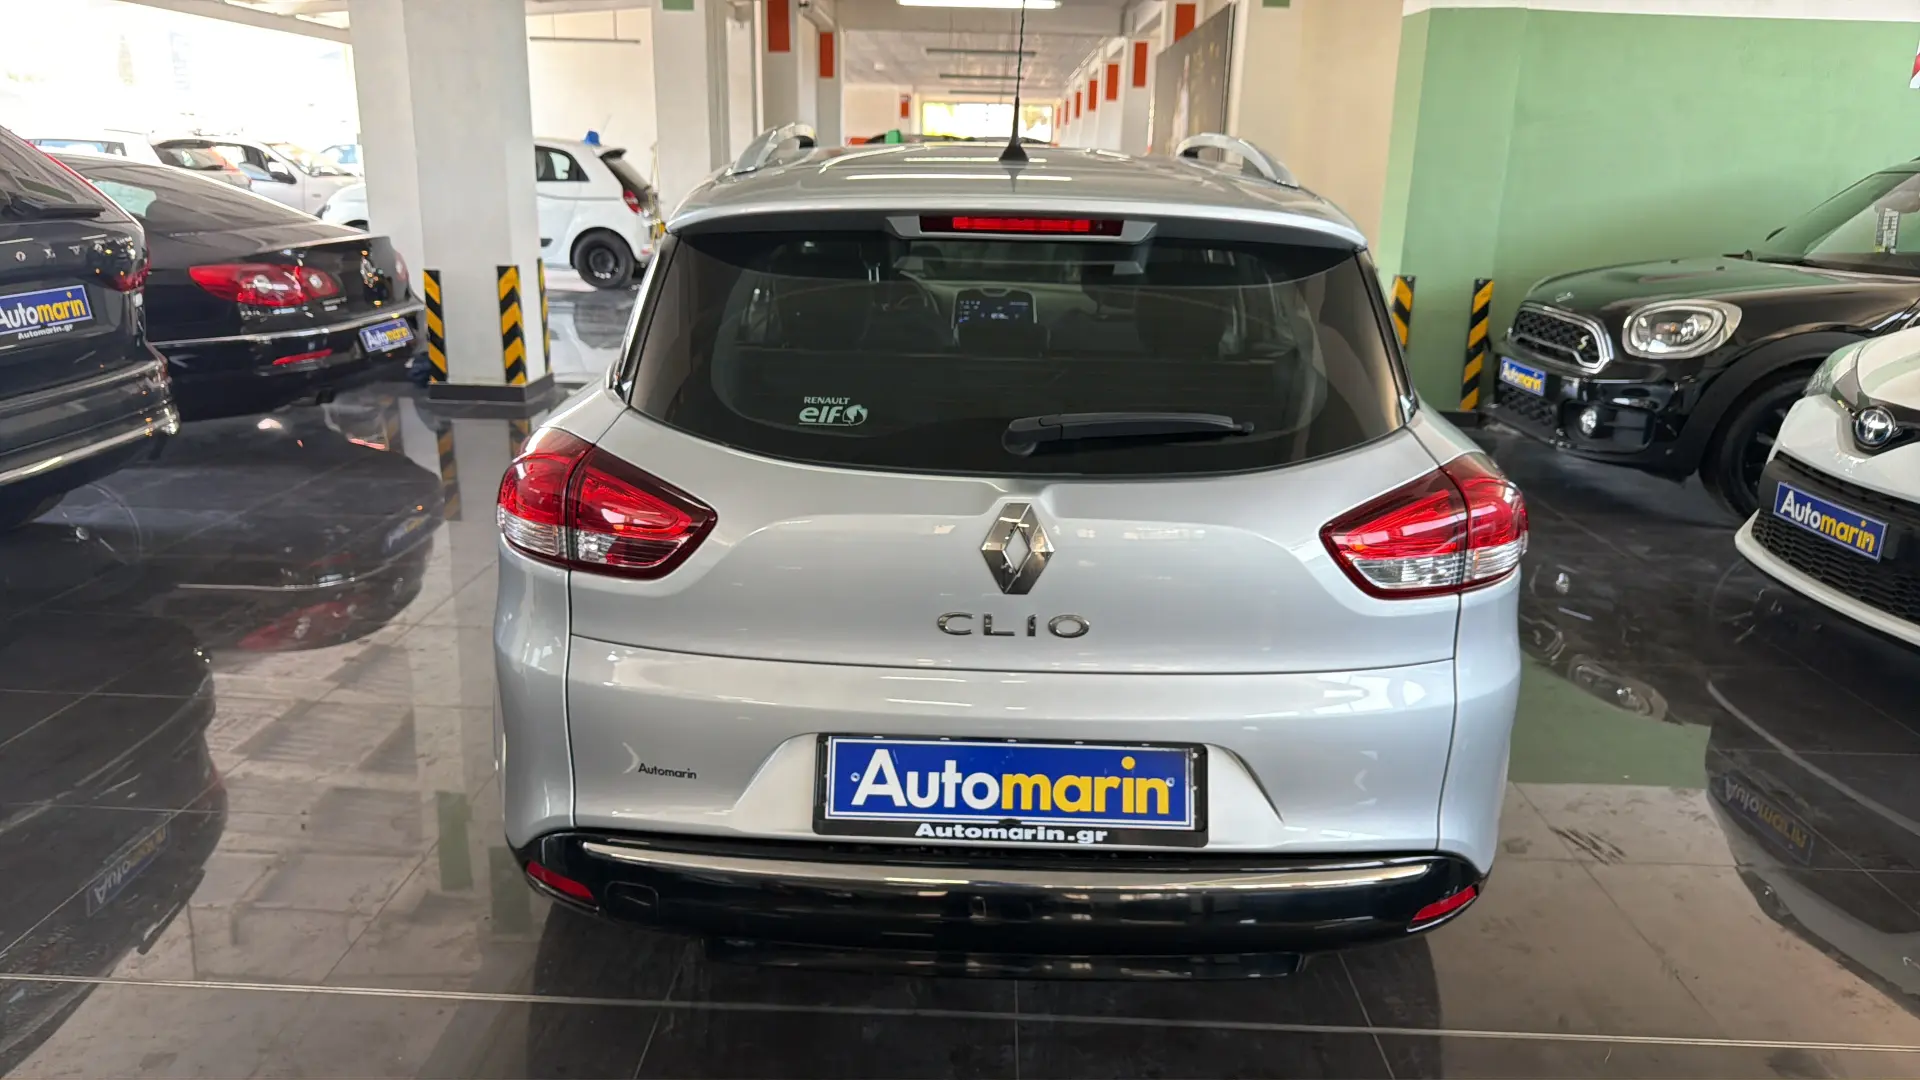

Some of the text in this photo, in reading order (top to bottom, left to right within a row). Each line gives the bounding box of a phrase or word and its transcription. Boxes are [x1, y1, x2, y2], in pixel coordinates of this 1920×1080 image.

[18, 322, 74, 340] Automarin.gr
[803, 396, 850, 405] RENAULT
[799, 405, 843, 423] elf
[1780, 489, 1875, 553] Automarin
[937, 611, 1091, 638] CLIO
[638, 762, 697, 780] Automarin
[850, 748, 1170, 814] Automarin
[915, 822, 1109, 844] Automarin.gr
